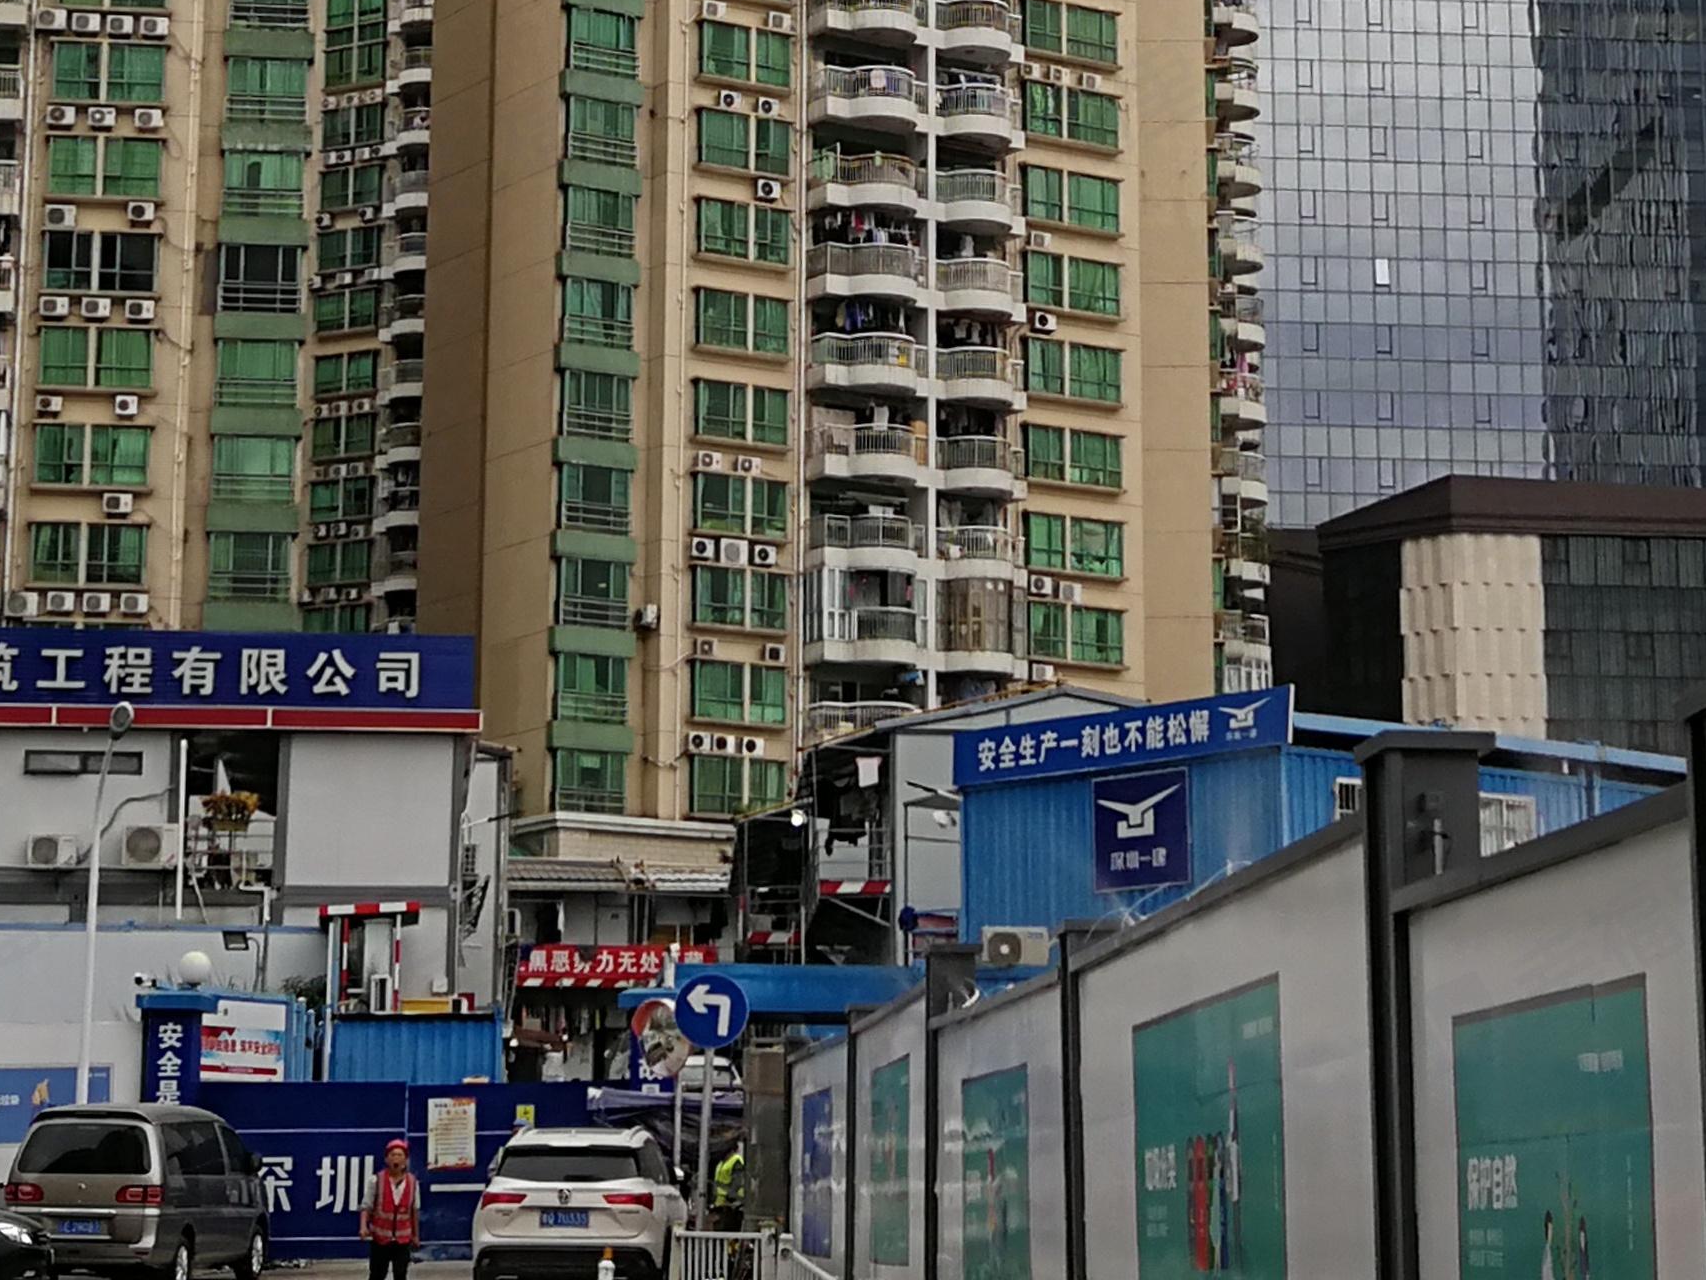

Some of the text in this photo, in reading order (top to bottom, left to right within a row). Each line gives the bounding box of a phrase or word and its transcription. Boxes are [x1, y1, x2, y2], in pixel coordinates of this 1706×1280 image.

[977, 709, 1210, 772] 安全生产一刻也不能松懈
